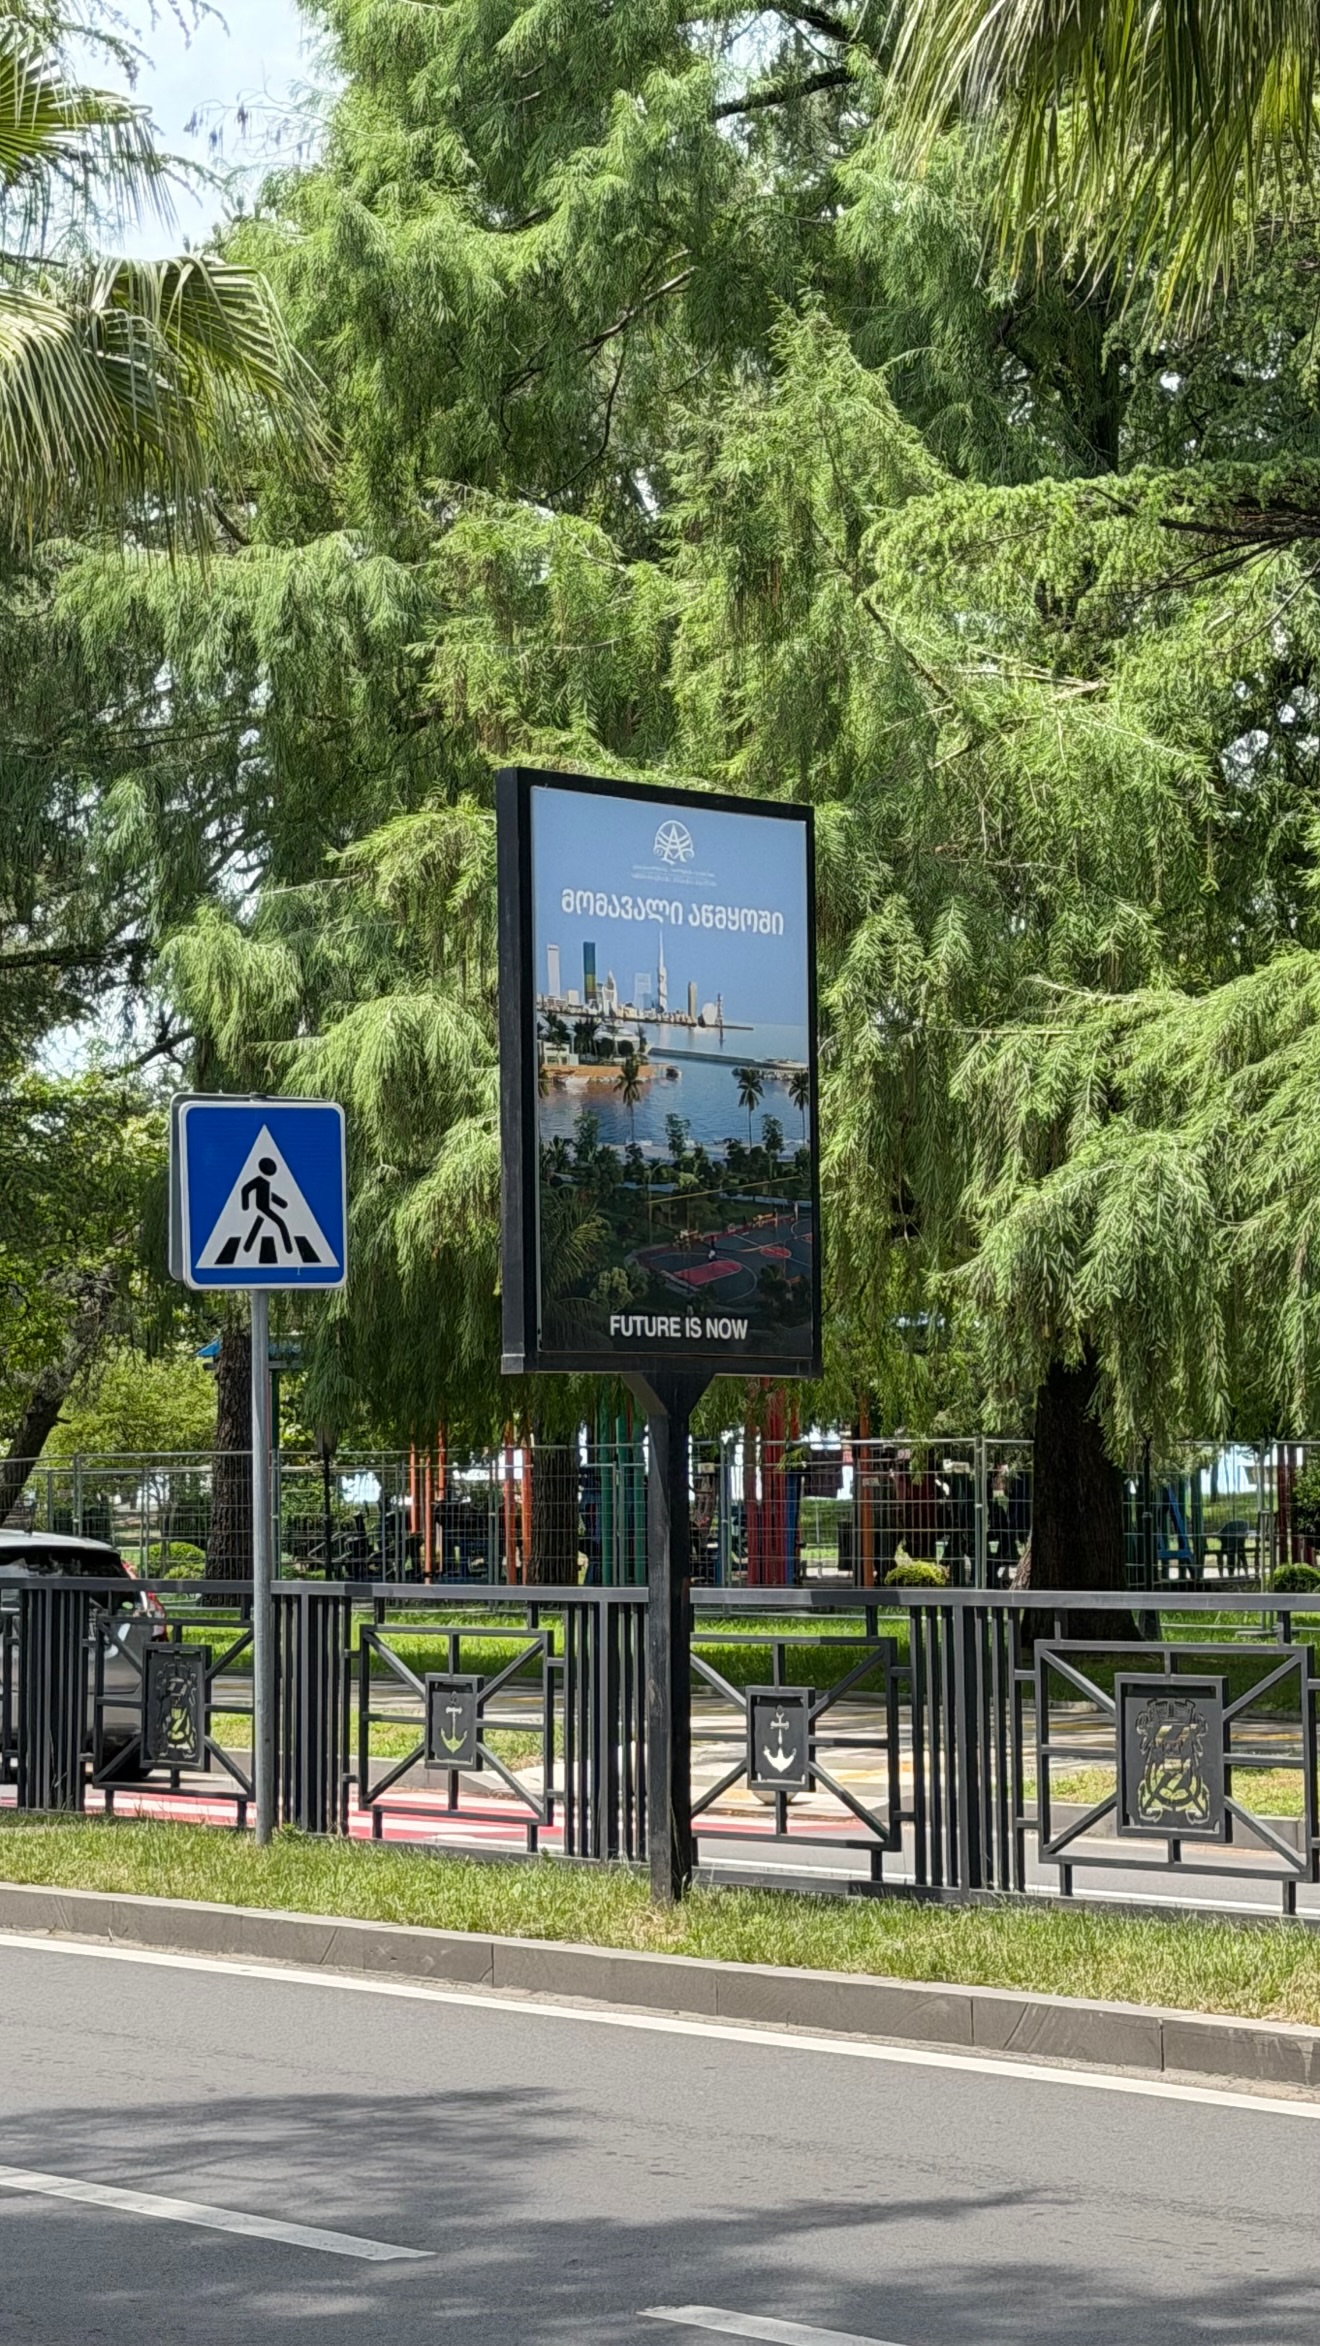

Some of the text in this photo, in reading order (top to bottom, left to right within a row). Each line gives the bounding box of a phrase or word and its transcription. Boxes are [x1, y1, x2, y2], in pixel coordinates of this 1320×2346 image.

[561, 888, 785, 936] მომავალი აწმყოში
[609, 1315, 749, 1340] FUTURE IS NOW
